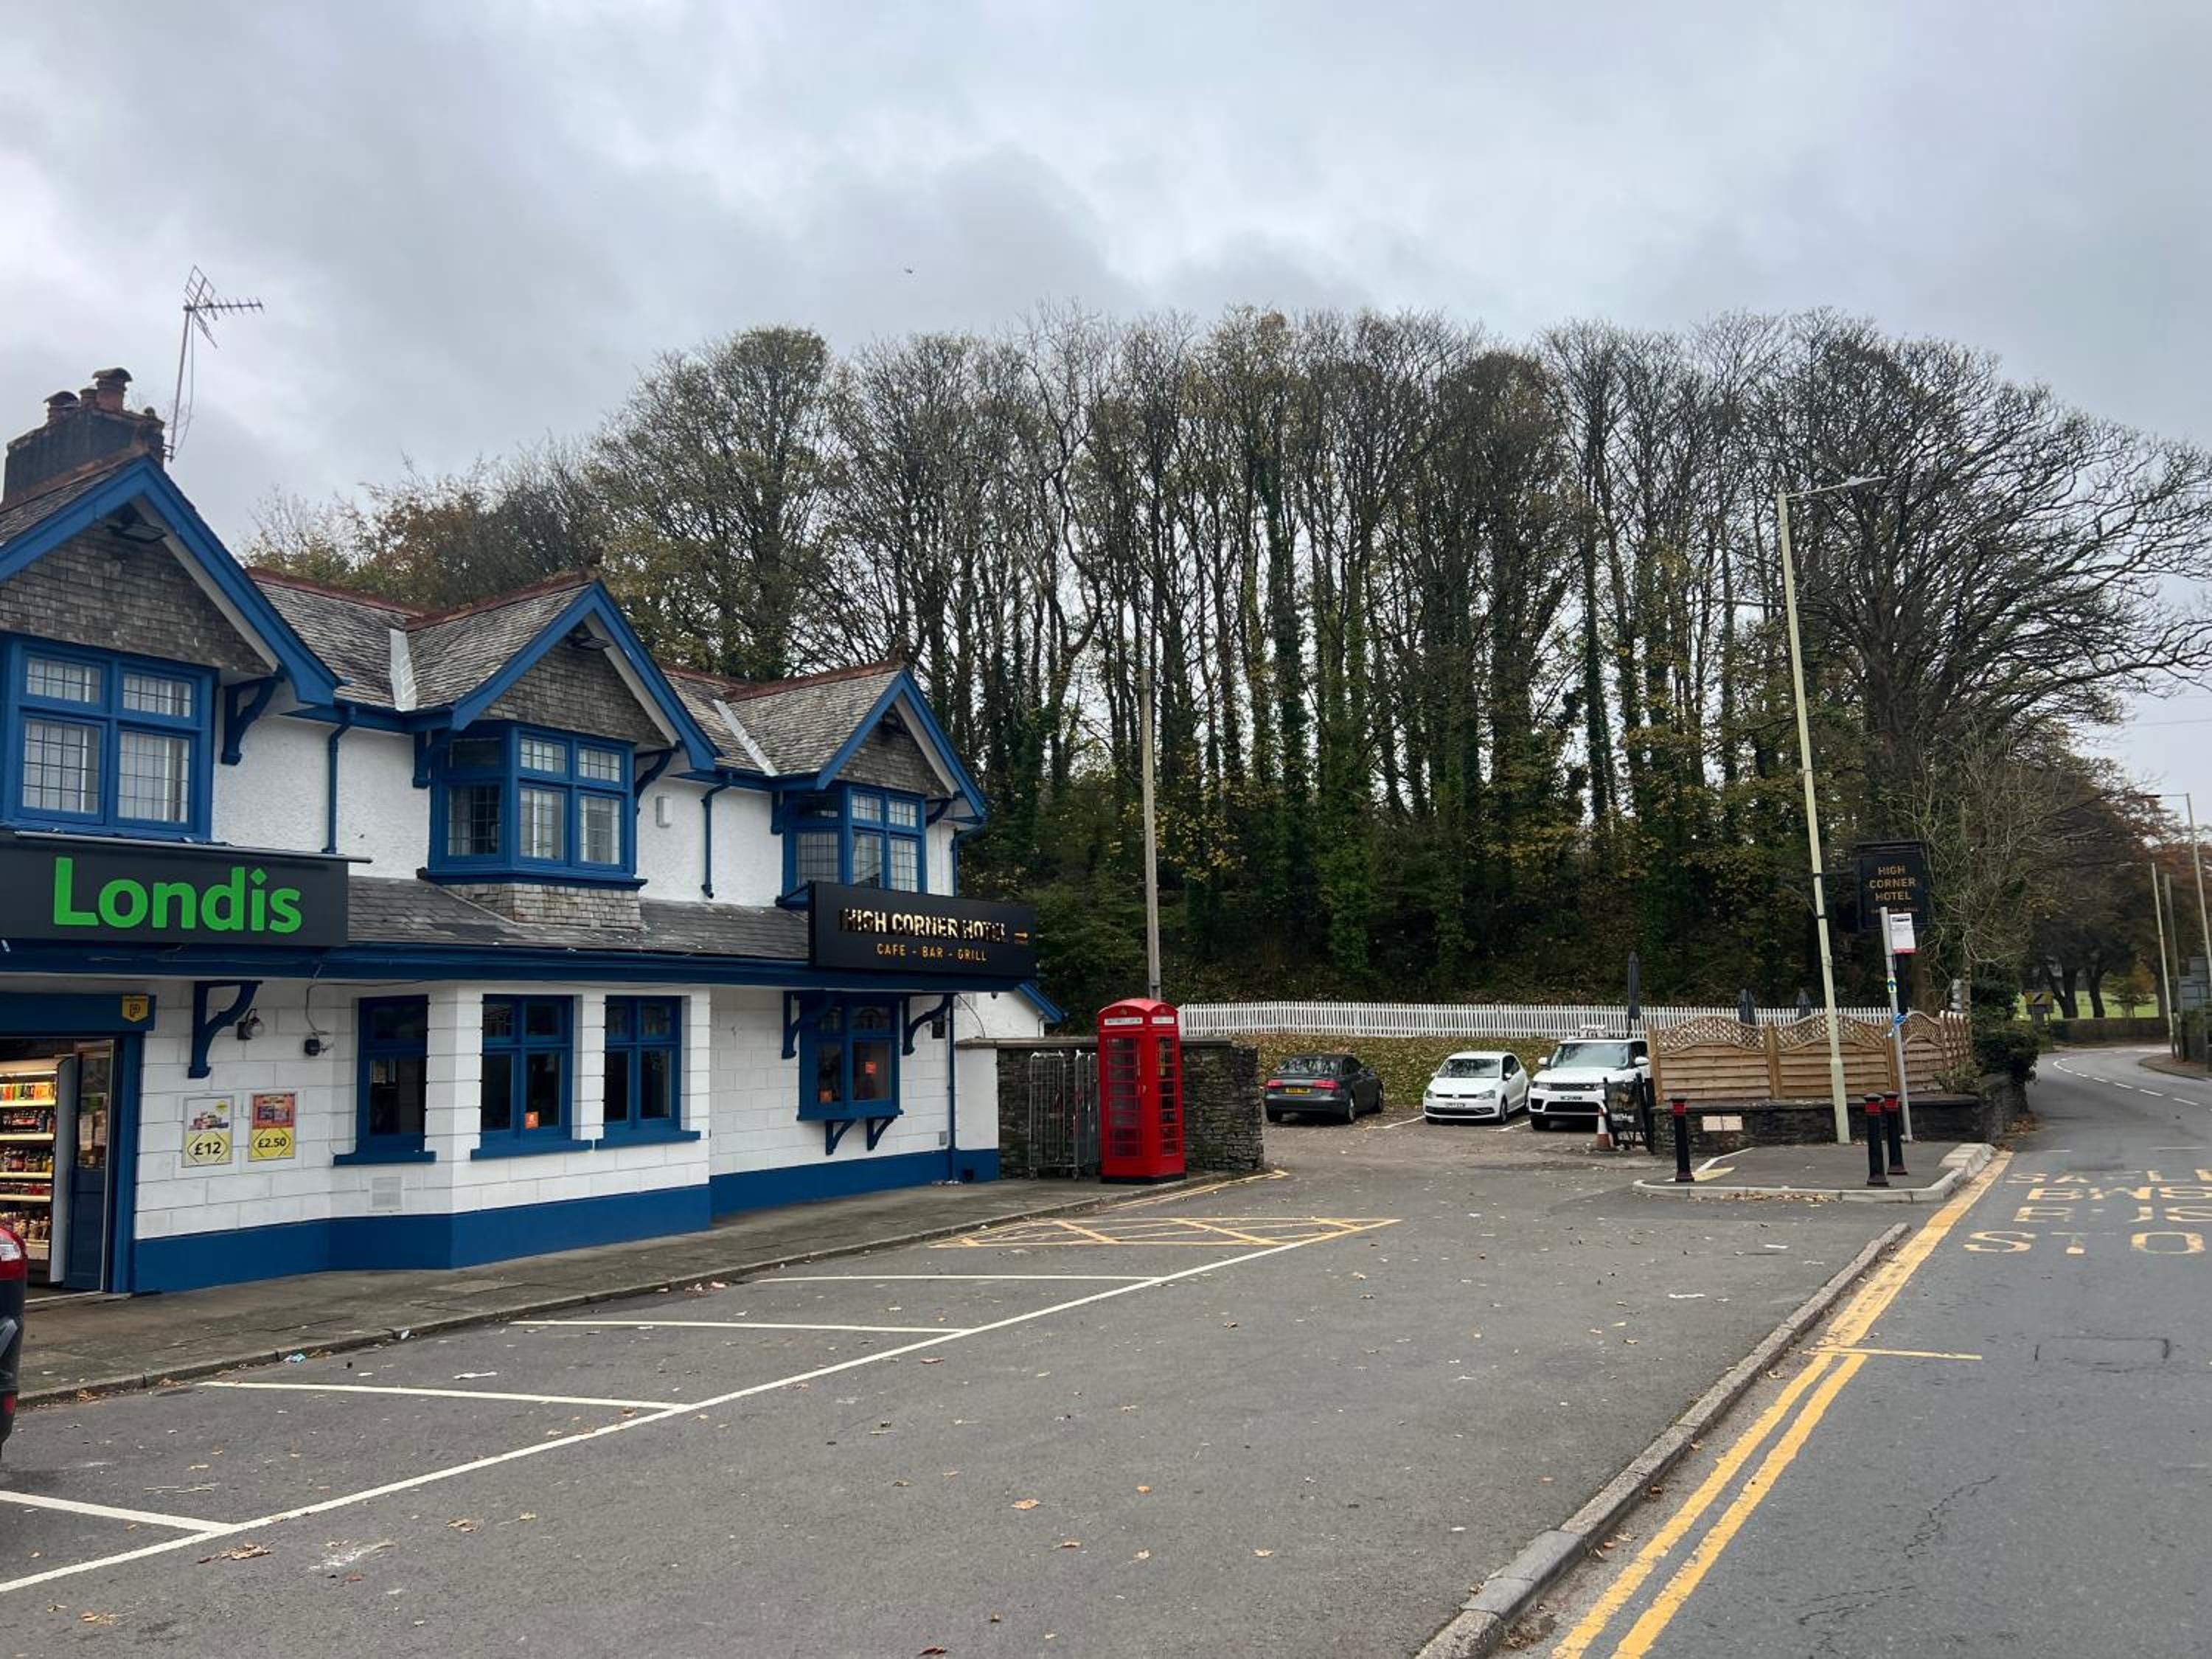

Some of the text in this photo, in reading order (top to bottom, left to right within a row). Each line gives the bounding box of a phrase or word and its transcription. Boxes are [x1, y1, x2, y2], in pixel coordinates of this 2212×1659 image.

[1878, 865, 1906, 876] HIGH
[1869, 877, 1917, 889] CORNER
[54, 857, 302, 933] Londis
[1875, 891, 1912, 901] HOTEL
[843, 908, 1007, 942] HIGH CORNER HOTEL
[876, 943, 906, 956] CAFE
[922, 945, 944, 958] BAR
[958, 948, 987, 961] GRILL
[194, 1141, 221, 1155] £12
[258, 1136, 287, 1148] £2.50
[1964, 1231, 2206, 1254] STO
